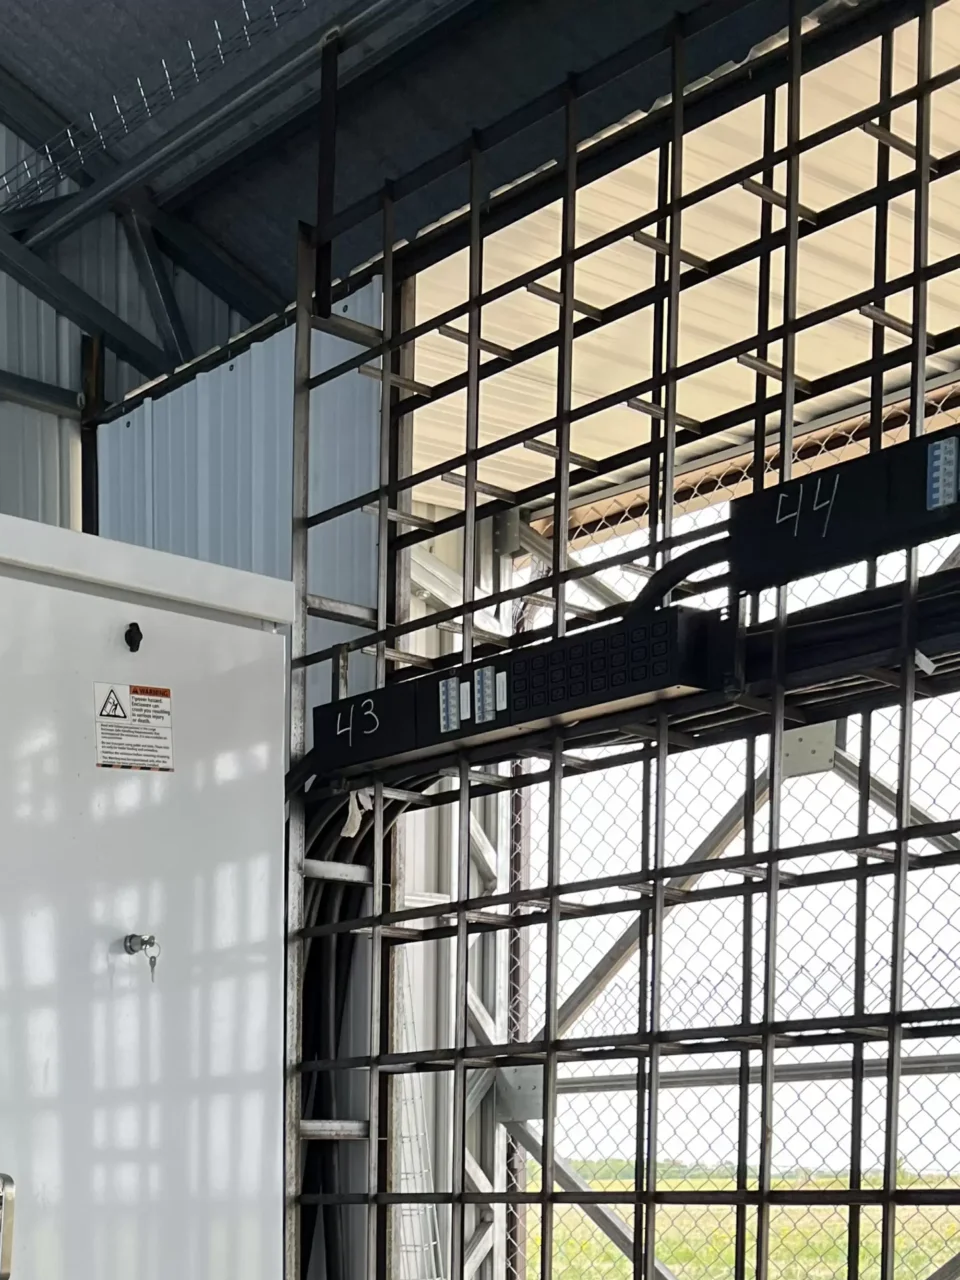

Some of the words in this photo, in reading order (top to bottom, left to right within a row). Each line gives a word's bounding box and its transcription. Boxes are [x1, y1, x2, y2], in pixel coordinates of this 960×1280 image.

[775, 472, 840, 538] 44
[139, 688, 169, 697] WARNING
[336, 699, 380, 746] 43
